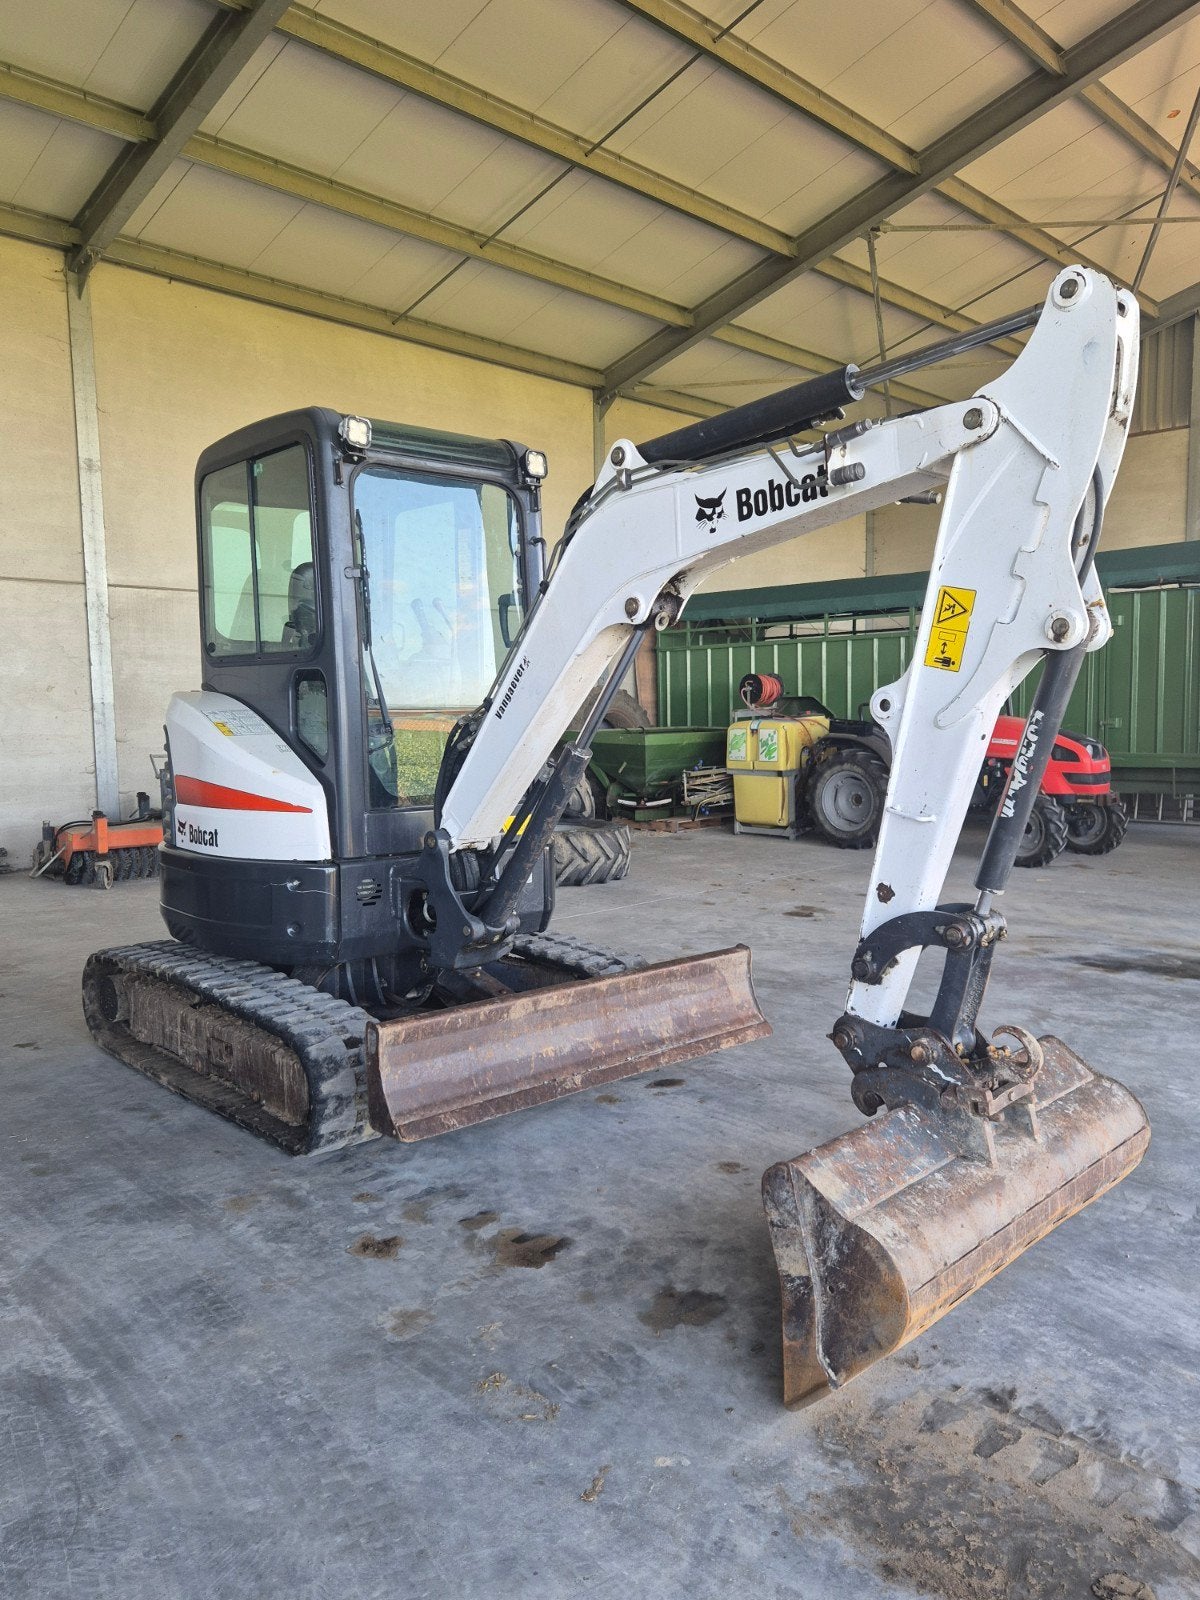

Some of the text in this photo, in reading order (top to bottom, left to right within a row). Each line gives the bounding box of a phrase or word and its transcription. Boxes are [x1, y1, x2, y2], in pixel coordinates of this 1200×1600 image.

[736, 464, 829, 522] Bobcat
[494, 663, 526, 720] vangaever
[189, 824, 219, 848] Bobcat
